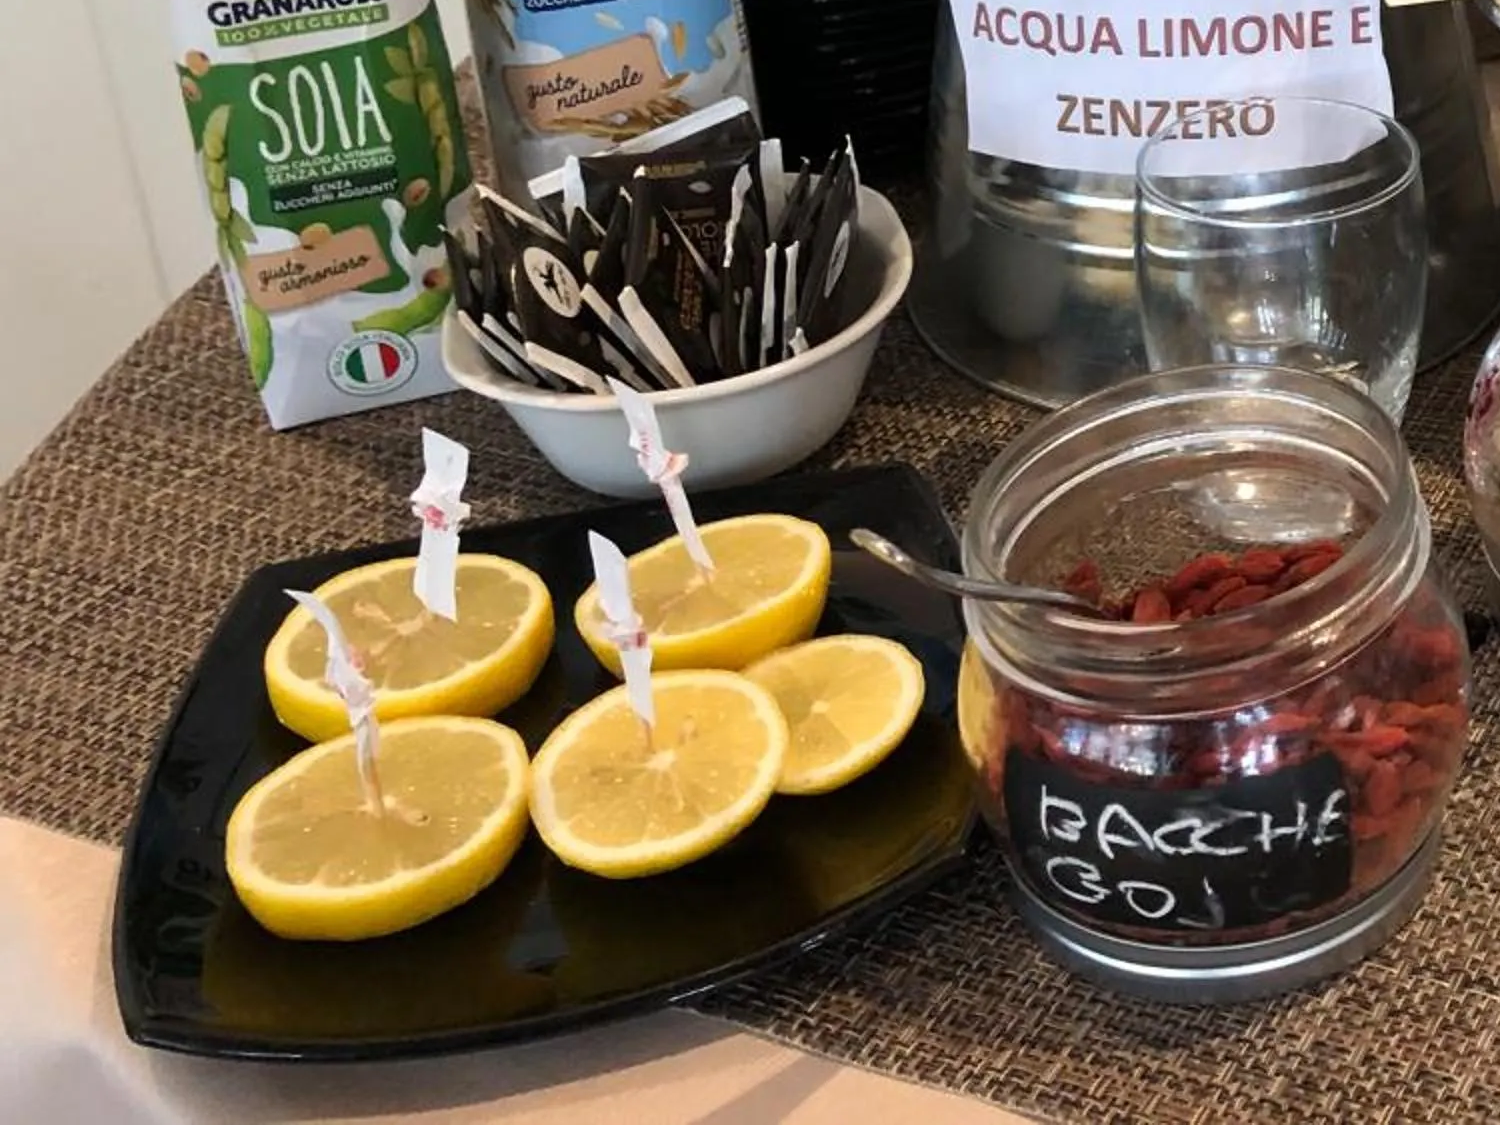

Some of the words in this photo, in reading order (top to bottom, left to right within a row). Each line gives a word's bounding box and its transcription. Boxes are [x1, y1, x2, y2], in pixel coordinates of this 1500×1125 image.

[973, 2, 1122, 56] ACQUA
[1137, 10, 1334, 58] LIMONE
[1351, 6, 1373, 44] E
[250, 56, 392, 163] SOIA
[527, 72, 578, 109] gusto
[557, 64, 643, 110] naturale
[1056, 93, 1277, 140] ZENZERO
[321, 154, 397, 176] LATTOSIO
[280, 254, 371, 294] armonioso
